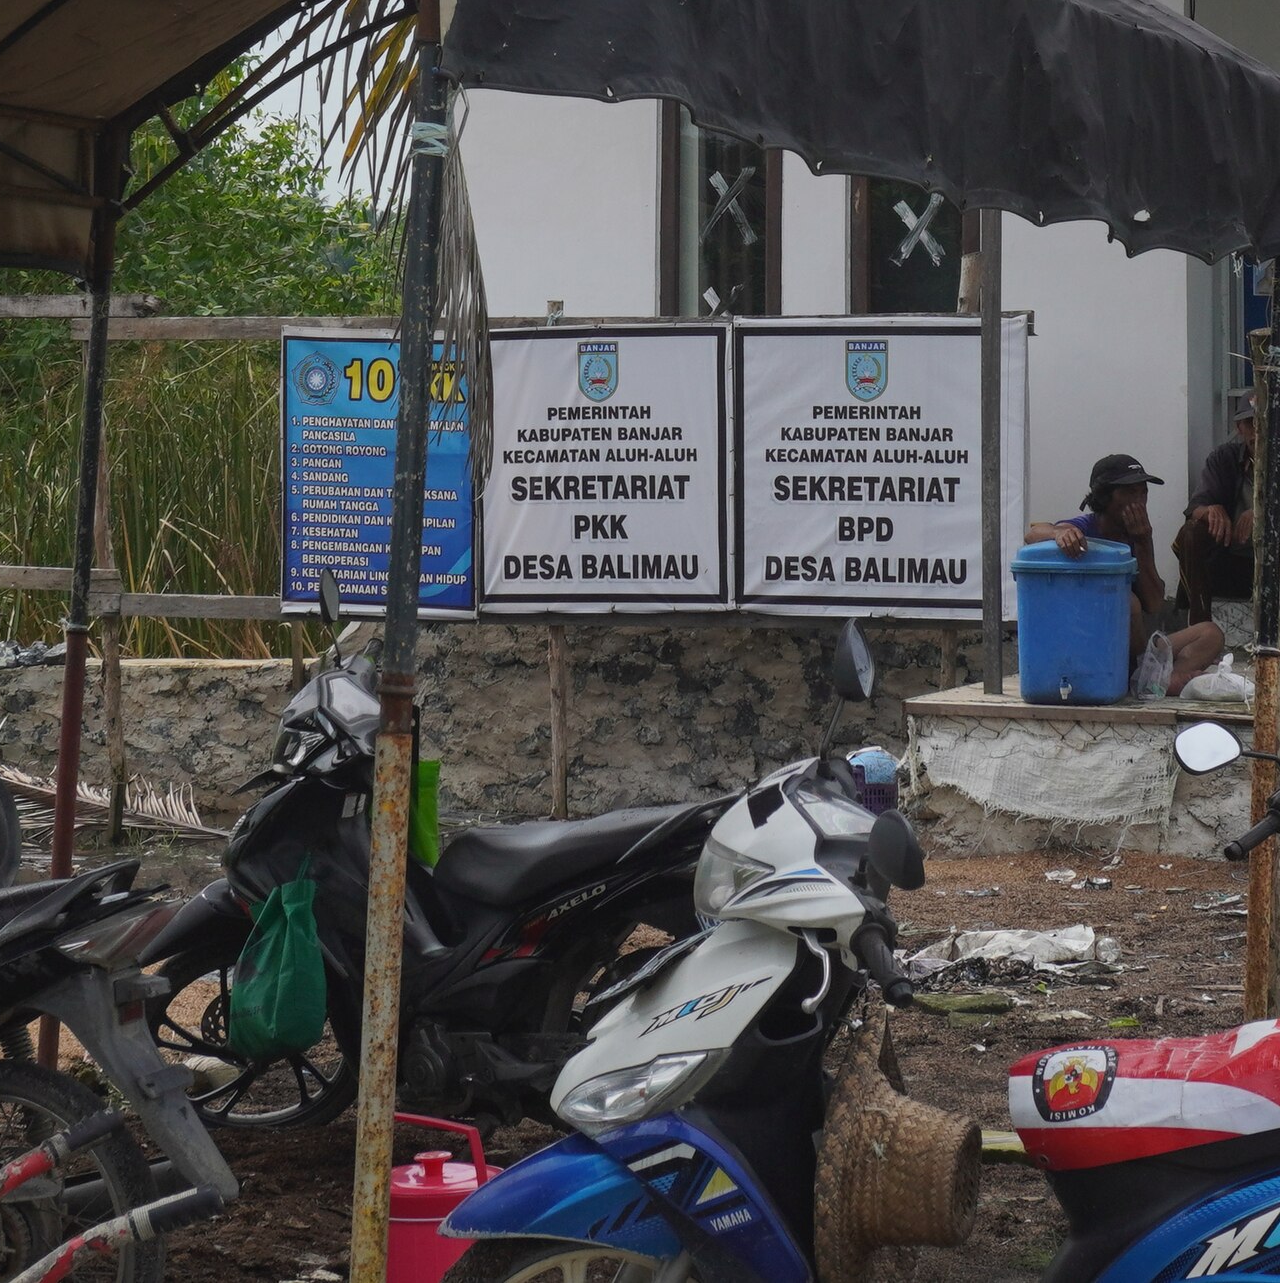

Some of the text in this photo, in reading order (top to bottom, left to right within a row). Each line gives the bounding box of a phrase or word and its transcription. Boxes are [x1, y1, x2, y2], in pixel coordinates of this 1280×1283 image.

[580, 344, 616, 352] BANJAR
[848, 342, 886, 351] BANJAR
[344, 357, 396, 402] 10
[547, 406, 651, 420] PEMERINTAH
[812, 406, 921, 420] PEMERINTAH
[292, 417, 300, 426] 1.
[302, 417, 371, 429] PENGHAYATAN
[374, 420, 394, 429] DAN
[302, 431, 356, 442] PANCASILA
[517, 427, 683, 442] KABUPATEN BANJAR
[781, 427, 954, 442] KABUPATEN BANJAR
[291, 444, 387, 456] 2. GOTONG ROYONG
[503, 448, 698, 464] KECAMATAN ALUH-ALUH
[765, 449, 969, 464] KECAMATAN ALUH-ALUH
[291, 458, 342, 468] 3. PANGAN
[291, 471, 349, 483] 4. SANDANG
[291, 486, 300, 495] 5.
[302, 486, 361, 497] PERUBAHAN
[364, 489, 384, 498] DAN
[511, 475, 690, 501] SEKRETARIAT
[774, 475, 960, 503] SEKRETARIAT
[302, 500, 379, 511] RUMAH TANGGA
[291, 513, 300, 522] 6.
[302, 514, 361, 525] PENDIDIKAN
[364, 517, 384, 526] DAN
[291, 527, 359, 538] 7. KESEHATAN
[574, 515, 629, 540] PKK
[838, 516, 894, 542] BPD
[291, 541, 300, 550] 8.
[302, 541, 382, 553] PENGEMBANGAN
[302, 554, 369, 566] BERKOPERASI
[503, 554, 699, 580] DESA BALIMAU
[290, 568, 299, 577] 9.
[436, 575, 467, 585] HIDUP
[765, 556, 967, 584] DESA BALIMAU
[291, 582, 305, 591] 10.
[546, 883, 607, 922] AXELO
[1049, 1104, 1095, 1120] KOMISI
[710, 1208, 752, 1232] YAMAHA
